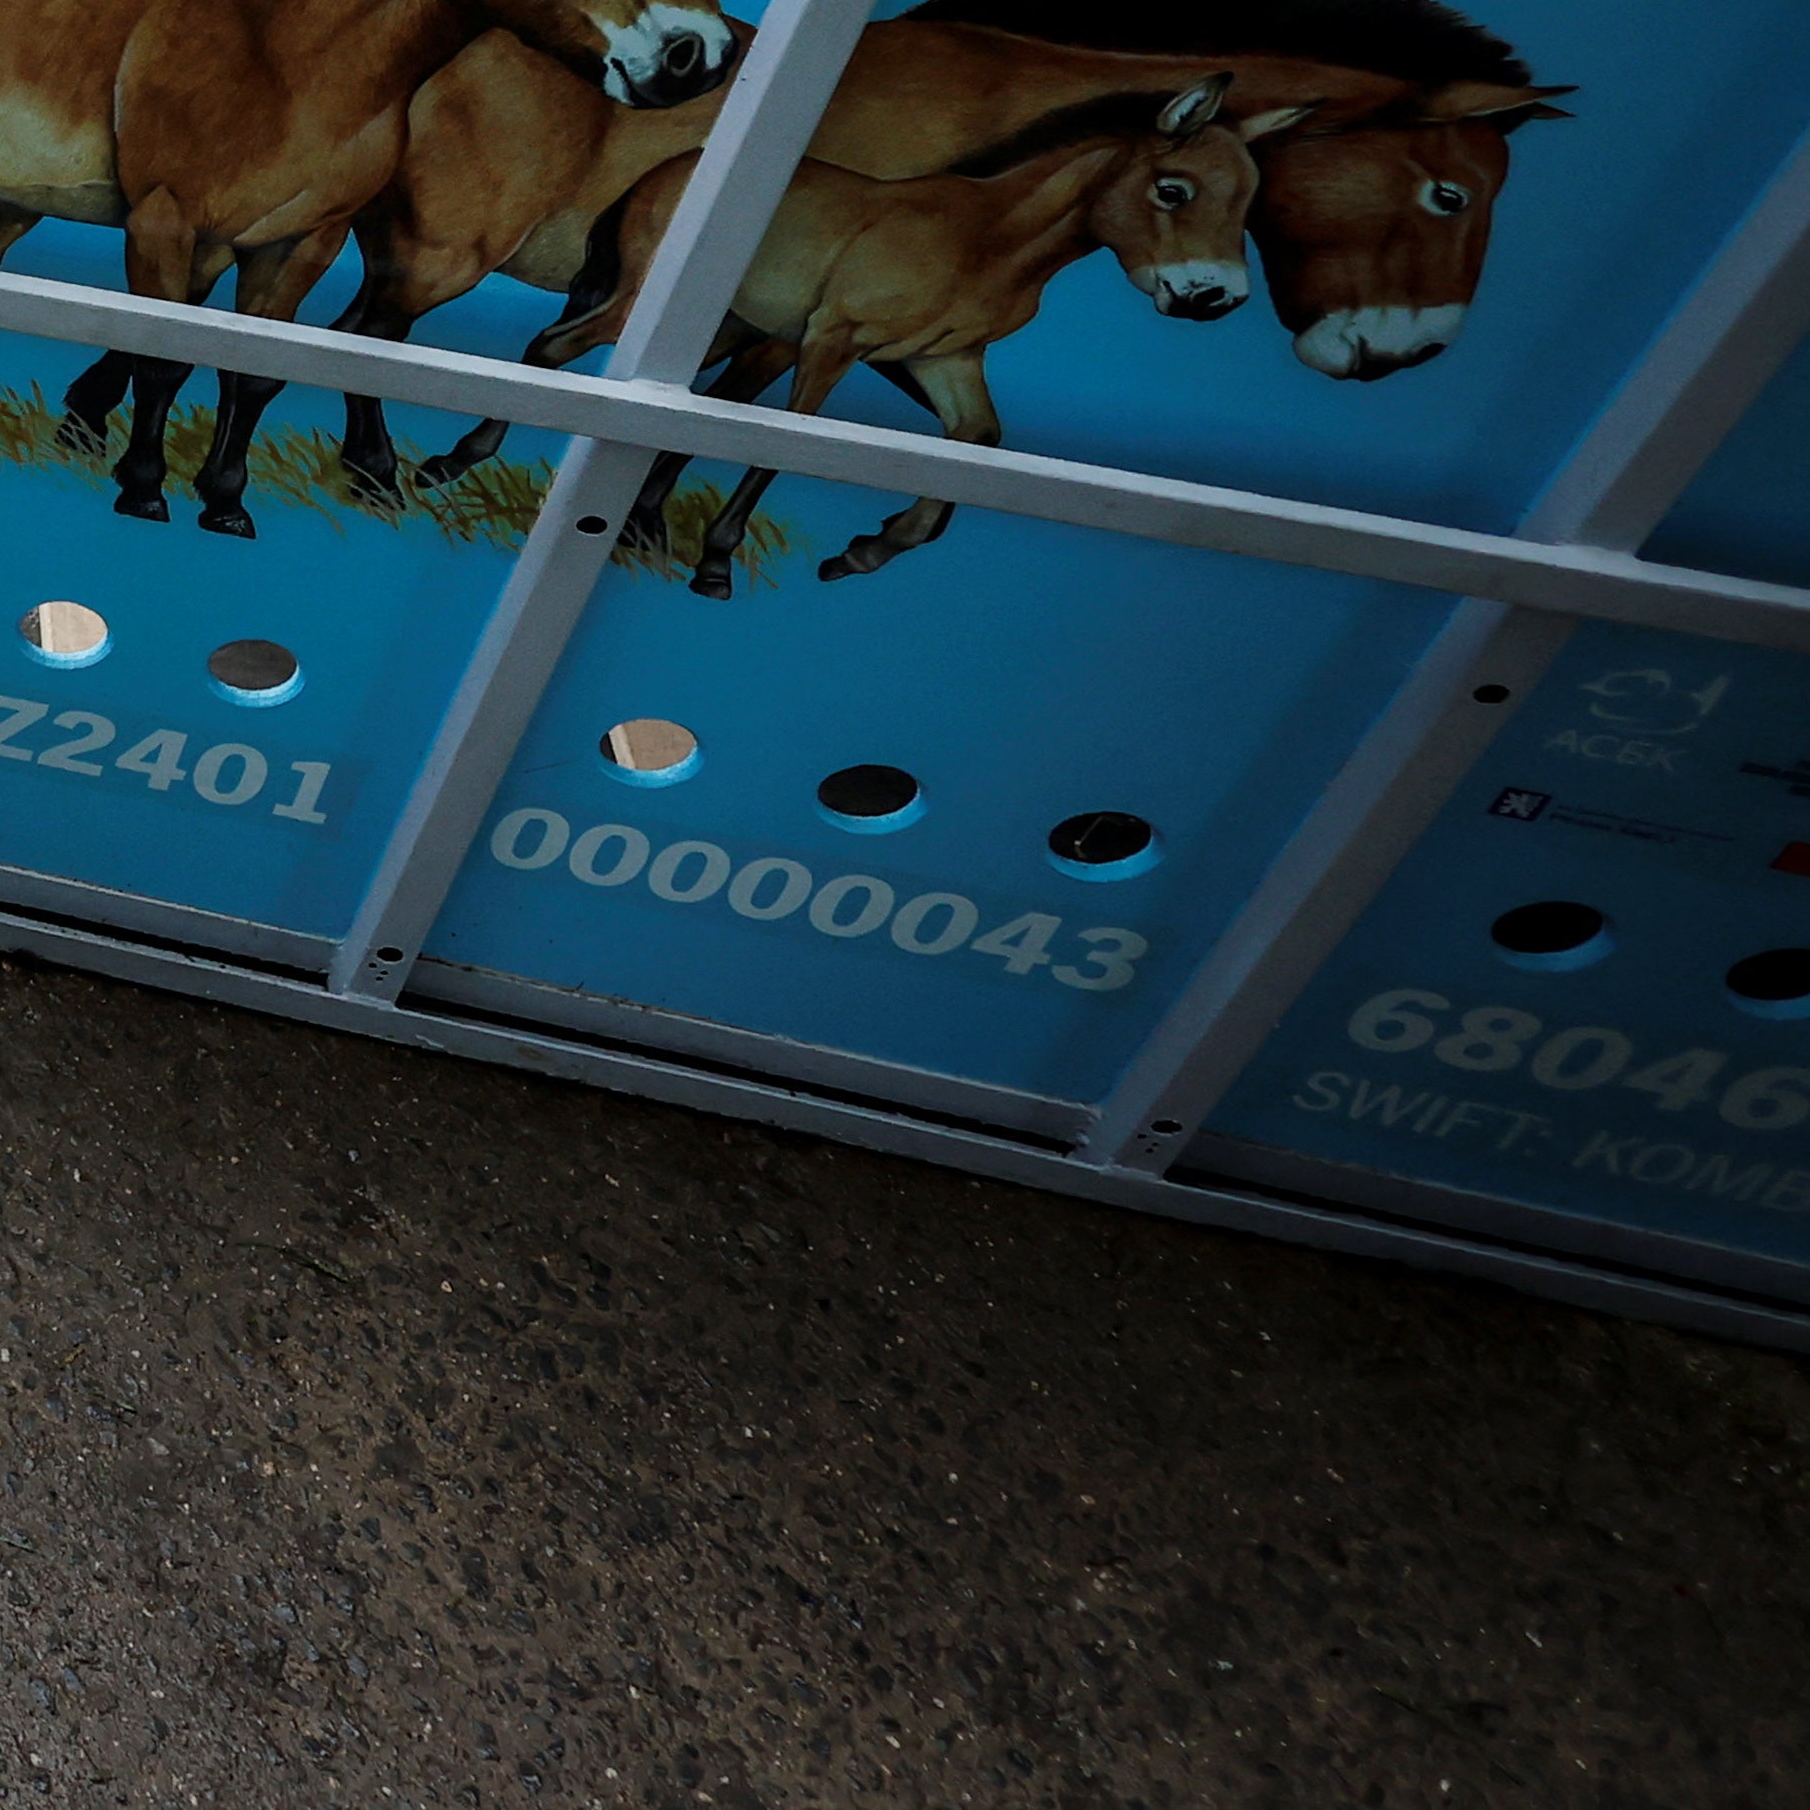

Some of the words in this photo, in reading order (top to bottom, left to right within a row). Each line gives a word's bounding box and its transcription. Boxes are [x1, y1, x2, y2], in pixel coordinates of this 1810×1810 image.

[489, 807, 1150, 991] 00000043
[1292, 1069, 1554, 1157] SWIFT:
[1347, 988, 1810, 1131] 68046
